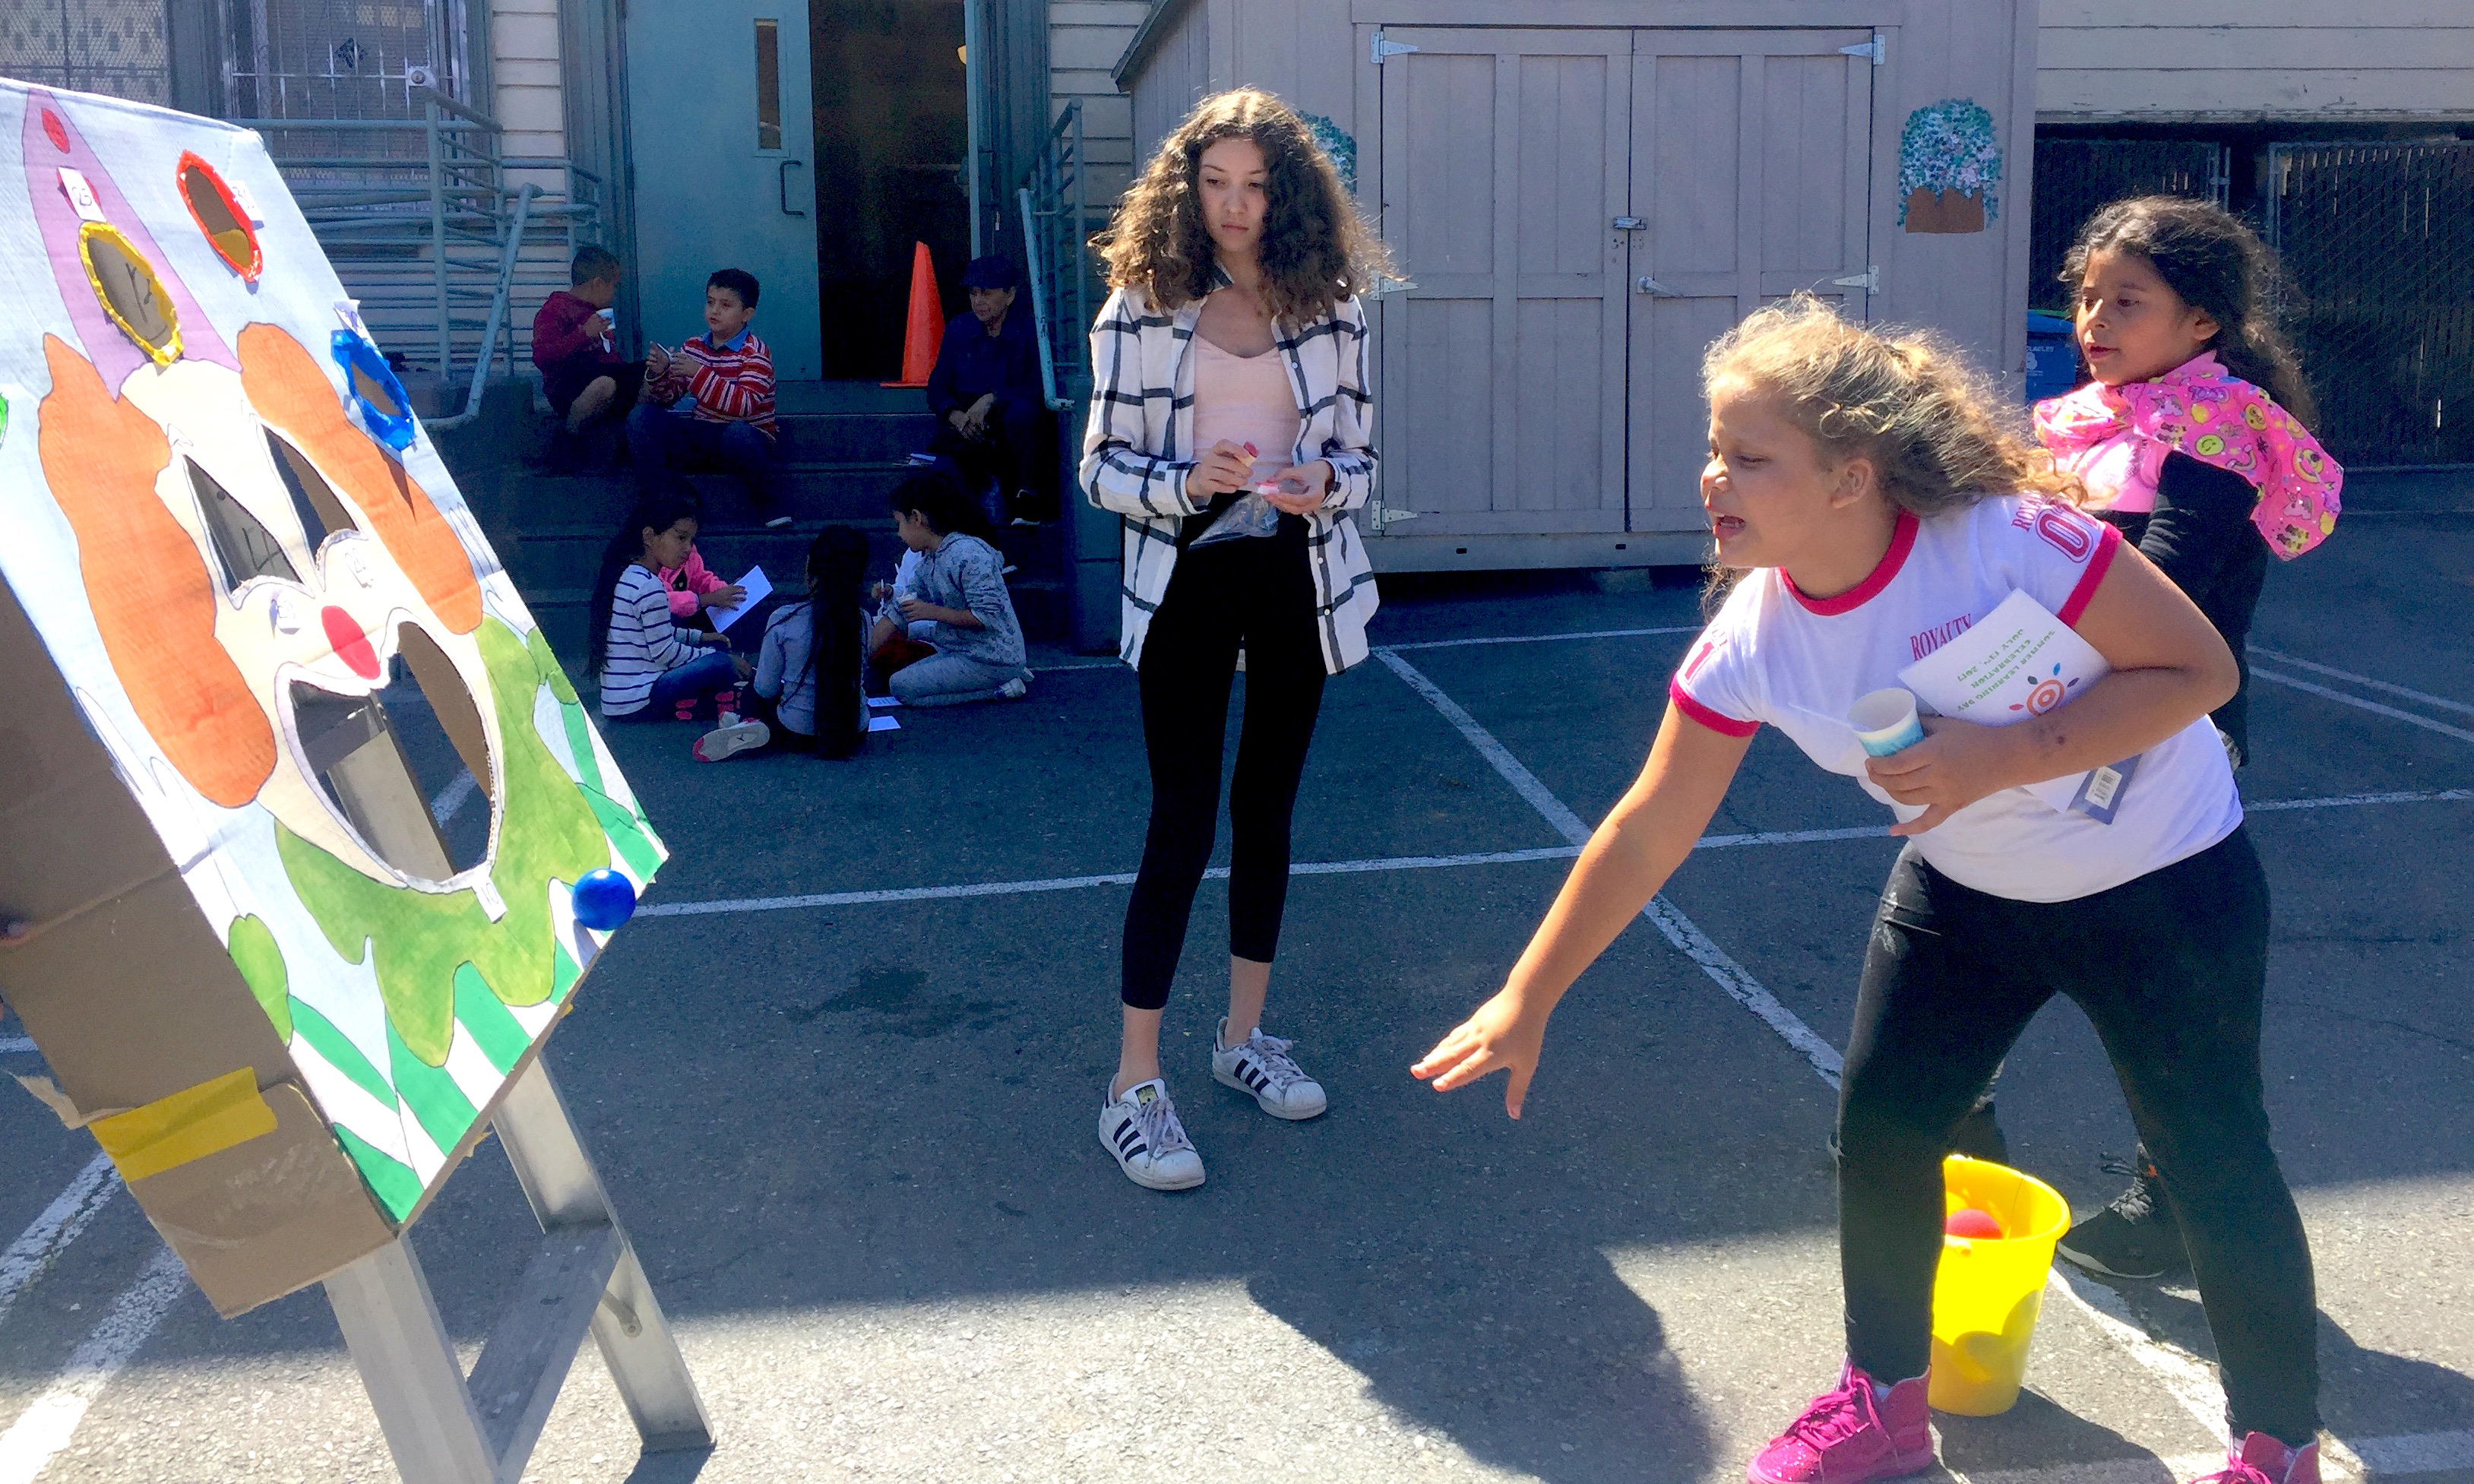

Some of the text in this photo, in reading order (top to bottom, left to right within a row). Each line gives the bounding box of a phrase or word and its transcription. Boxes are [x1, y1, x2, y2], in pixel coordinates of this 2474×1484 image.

[1971, 639, 2031, 689] CELEBRATION
[2001, 628, 2023, 650] JULY
[1957, 630, 2056, 712] SUMMER LEARNING DAY
